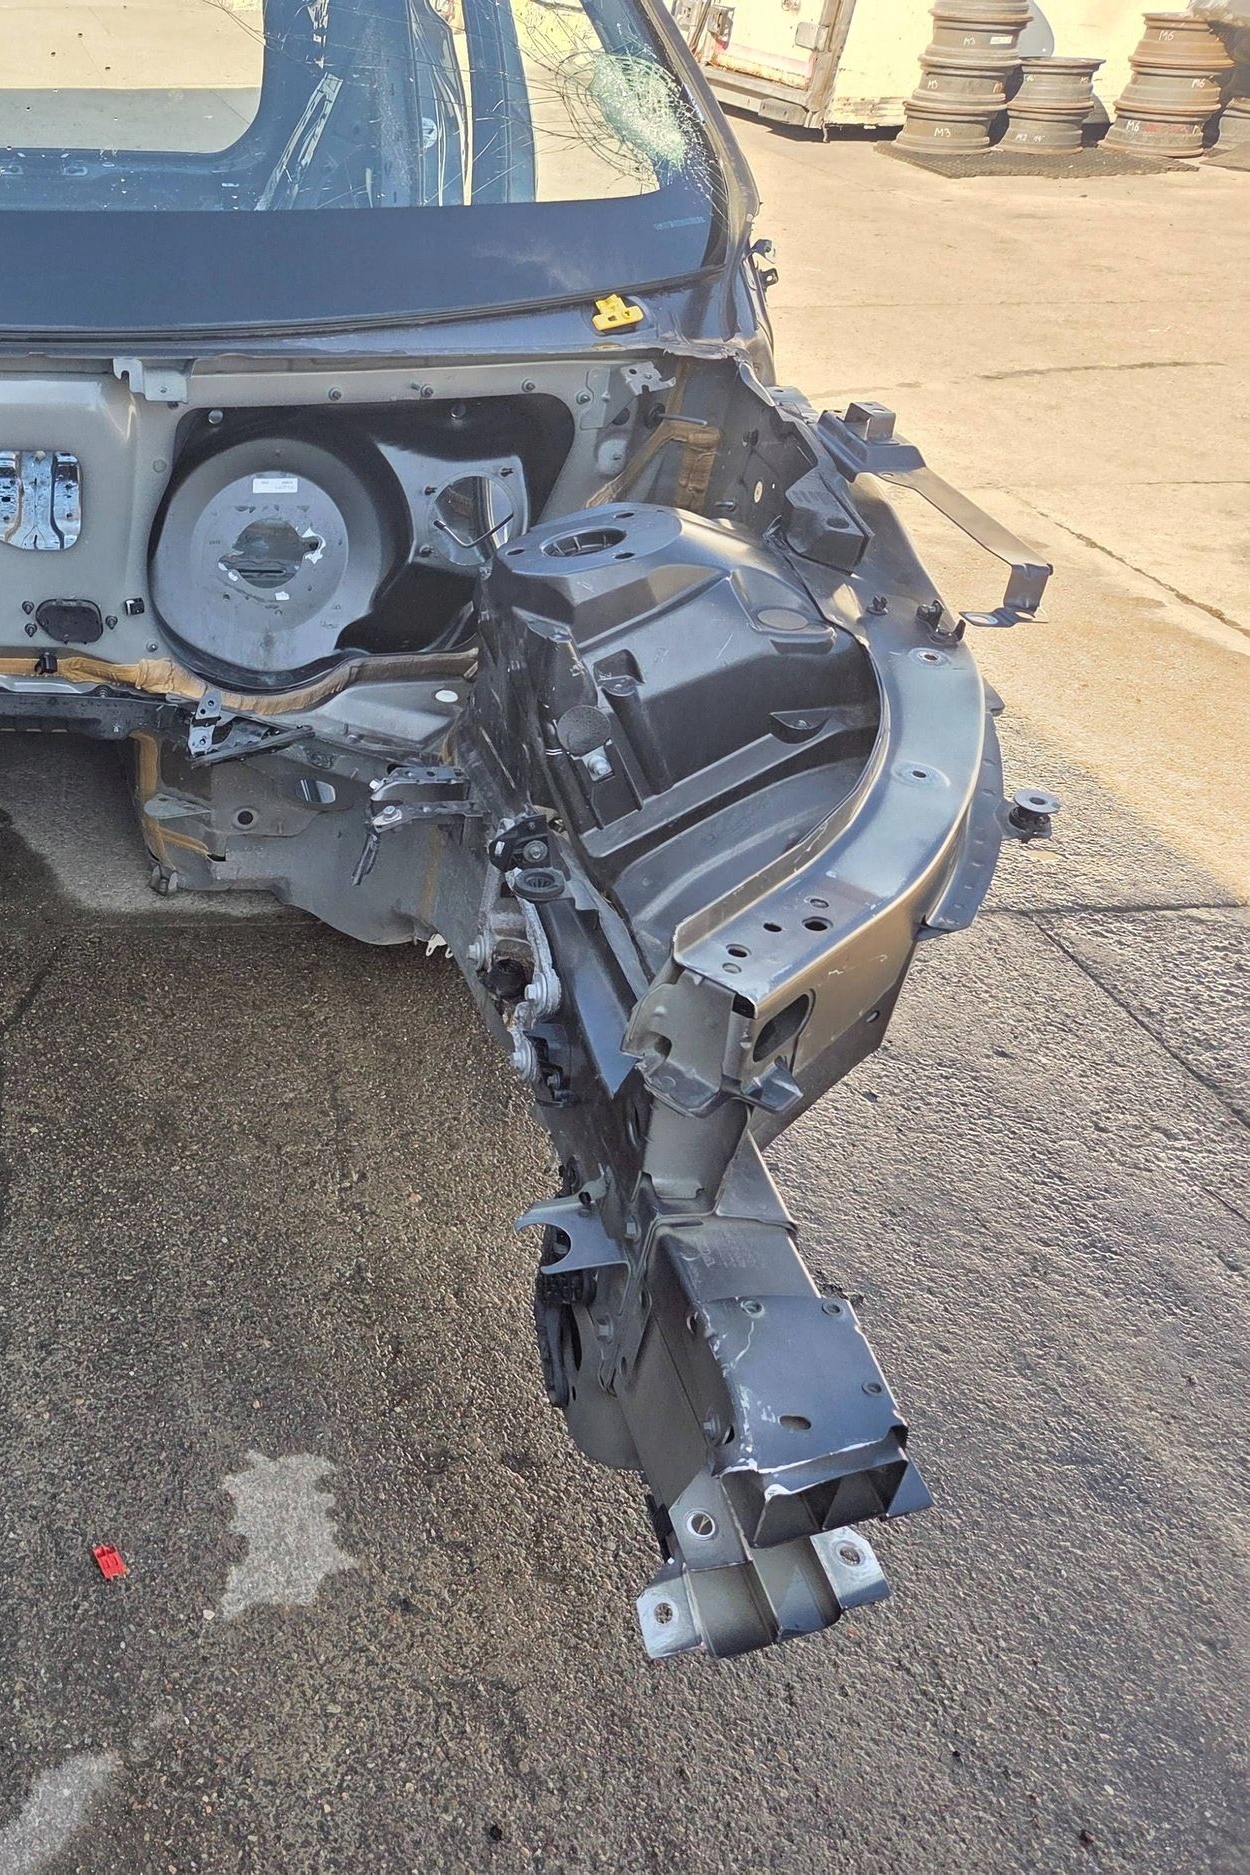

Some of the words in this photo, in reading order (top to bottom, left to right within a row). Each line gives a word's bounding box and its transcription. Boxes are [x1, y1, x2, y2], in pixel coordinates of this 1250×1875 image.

[1159, 29, 1175, 41] M6
[1191, 78, 1206, 89] M6
[1125, 120, 1141, 132] M6
[933, 127, 951, 138] M3
